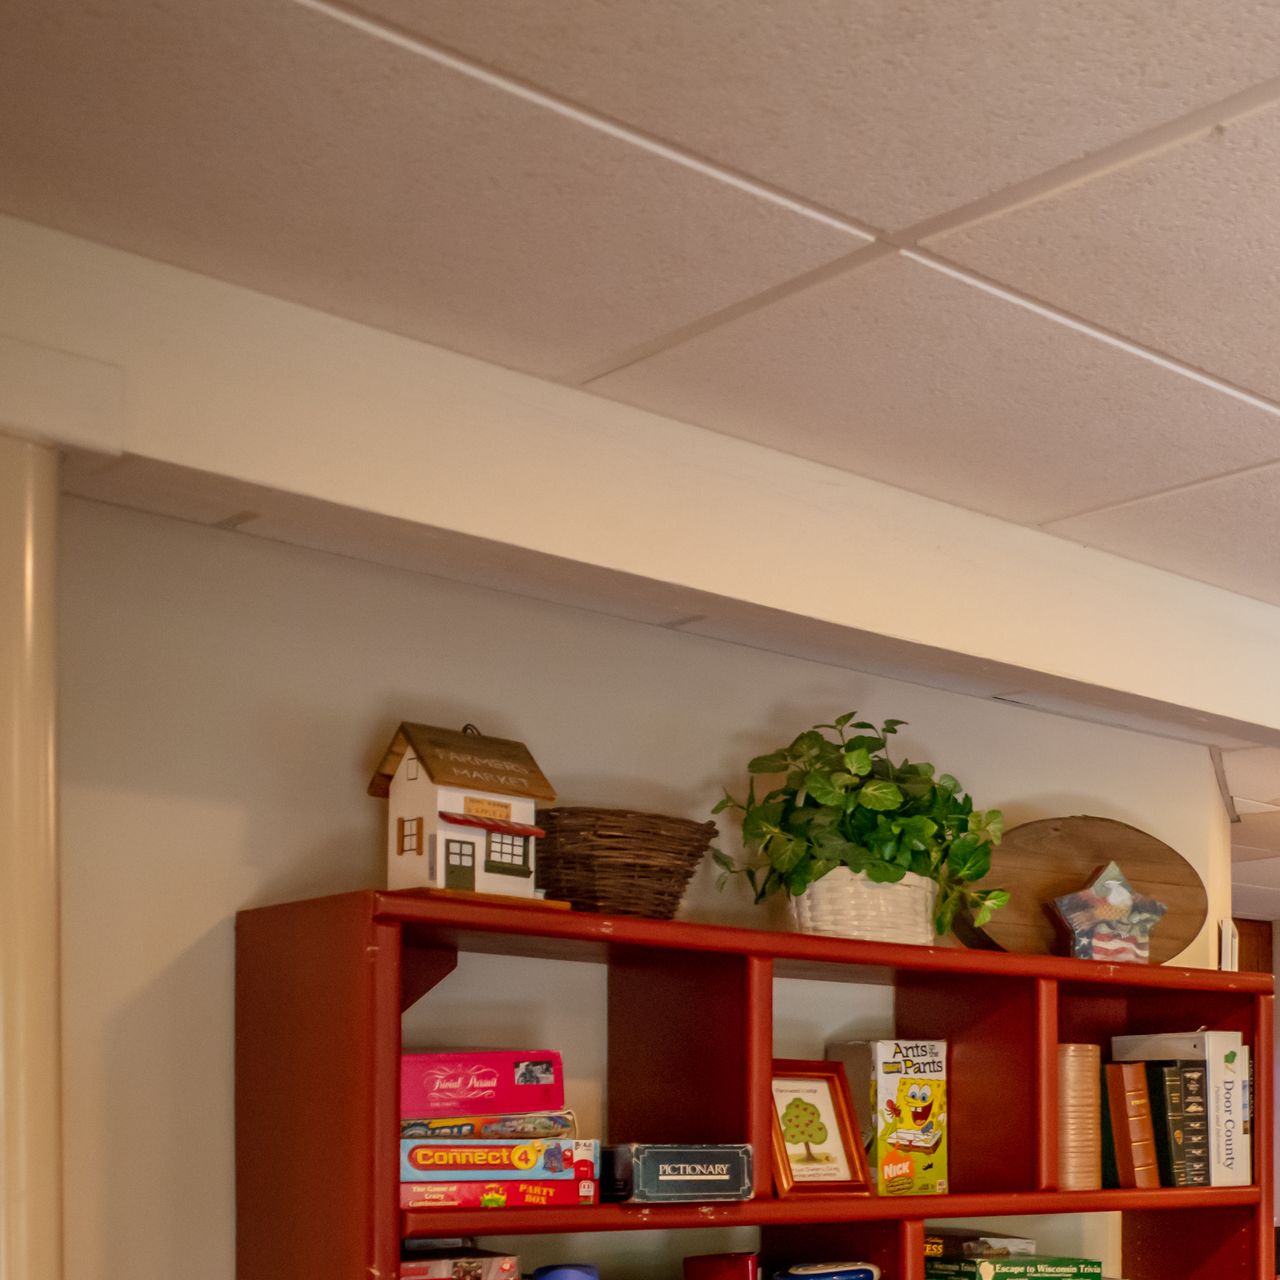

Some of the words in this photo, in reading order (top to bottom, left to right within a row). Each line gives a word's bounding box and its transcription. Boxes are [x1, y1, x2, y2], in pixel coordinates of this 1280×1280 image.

[893, 1043, 928, 1058] Ants
[902, 1059, 943, 1074] Pants
[433, 1075, 463, 1091] Trivial
[1223, 1080, 1235, 1115] Door
[1222, 1119, 1236, 1170] County
[416, 1149, 510, 1165] Connect
[517, 1149, 531, 1165] 4
[658, 1163, 730, 1175] PICTIONARY
[884, 1161, 910, 1179] NICK
[519, 1184, 555, 1197] PARTY
[524, 1194, 547, 1205] BOX
[995, 1263, 1025, 1274] Escape
[1026, 1265, 1035, 1273] to
[1037, 1264, 1077, 1273] Wisconsin
[1079, 1264, 1101, 1273] Trivia
